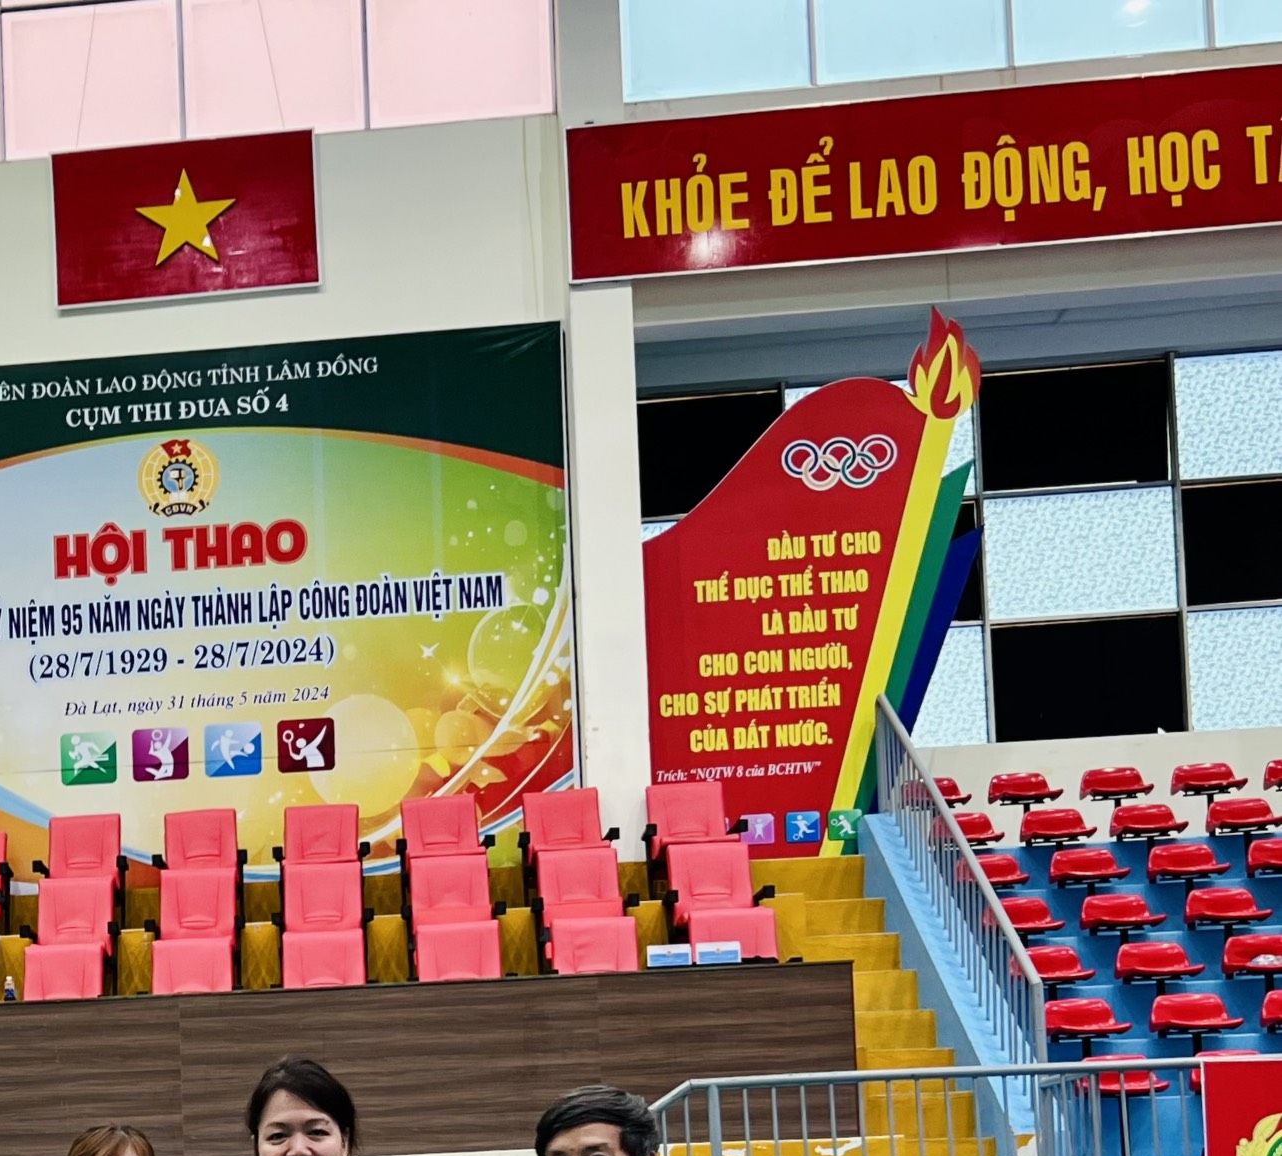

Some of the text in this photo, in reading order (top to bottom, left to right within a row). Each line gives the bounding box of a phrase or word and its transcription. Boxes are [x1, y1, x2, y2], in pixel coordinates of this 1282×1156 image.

[620, 116, 1282, 239] KHỎE ĐỂ LAO ĐỘNG, HỌC T
[32, 374, 91, 400] ĐOÀN
[95, 376, 137, 395] LAO
[142, 367, 203, 394] ĐỘNG
[207, 363, 260, 386] TỈNH
[265, 359, 312, 382] LÂM
[316, 353, 379, 378] ĐỒNG
[65, 386, 289, 431] CỤM THI ĐUA SỐ 4
[53, 518, 309, 587] HỘI THAO
[767, 530, 881, 562] ĐẦU TƯ CHO
[694, 564, 869, 604] THỂ DỤC THỂ THAO
[8, 599, 55, 645] NIỆM
[61, 604, 83, 636] 95
[88, 594, 131, 633] NĂM
[137, 590, 186, 631] NGÀY
[191, 587, 252, 627] THÀNH
[258, 583, 293, 629] LẬP
[299, 580, 350, 620] CÔNG
[356, 576, 407, 616] ĐOÀN
[413, 572, 453, 619] VIỆT
[458, 575, 504, 609] NAM
[762, 603, 858, 637] LÀ ĐẦU TƯ
[29, 647, 168, 684] (28/7/1929
[194, 636, 335, 669] 28/7/2024)
[699, 642, 853, 677] CHO CON NGƯỜI,
[64, 686, 329, 717] Đà Lạt, ngày 31 tháng 5 năm 2024
[660, 676, 840, 717] CHO SỰ PHÁT TRIỂN
[690, 719, 833, 752] CỦA ĐẤT NƯỚC.
[656, 769, 688, 782] Trích:
[736, 767, 743, 777] 8
[745, 764, 764, 777] của
